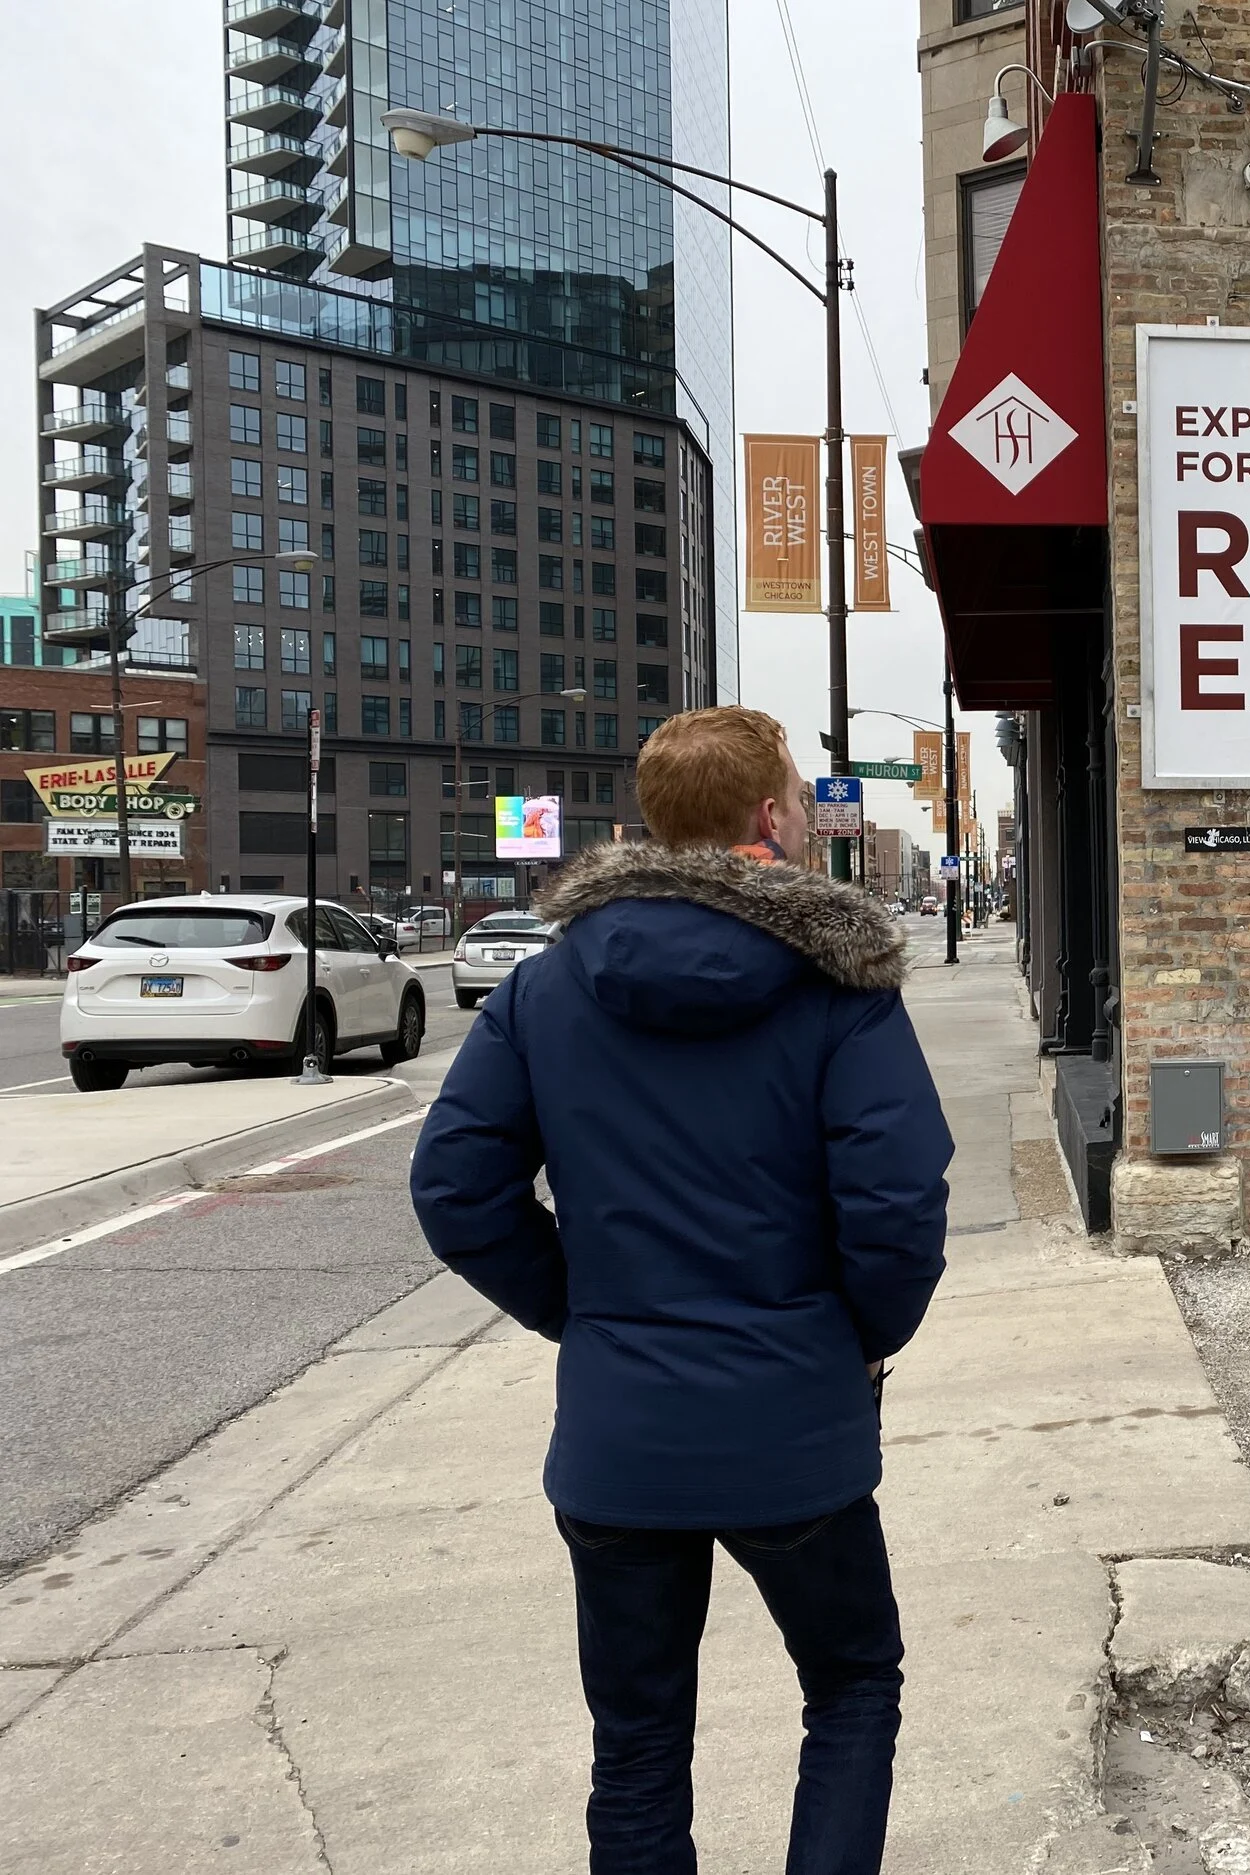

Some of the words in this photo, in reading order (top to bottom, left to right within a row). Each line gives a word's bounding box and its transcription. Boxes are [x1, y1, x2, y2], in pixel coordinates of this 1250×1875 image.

[862, 466, 877, 520] TOWN
[763, 476, 783, 546] RIVER
[786, 478, 806, 546] WEST
[863, 528, 879, 581] WEST
[764, 591, 803, 600] CHICAGO
[866, 765, 908, 778] HURON
[911, 768, 920, 776] ST
[930, 748, 938, 775] WEST
[59, 795, 109, 810] BODY
[141, 840, 178, 848] REPAIRS
[1187, 836, 1207, 844] VIEW
